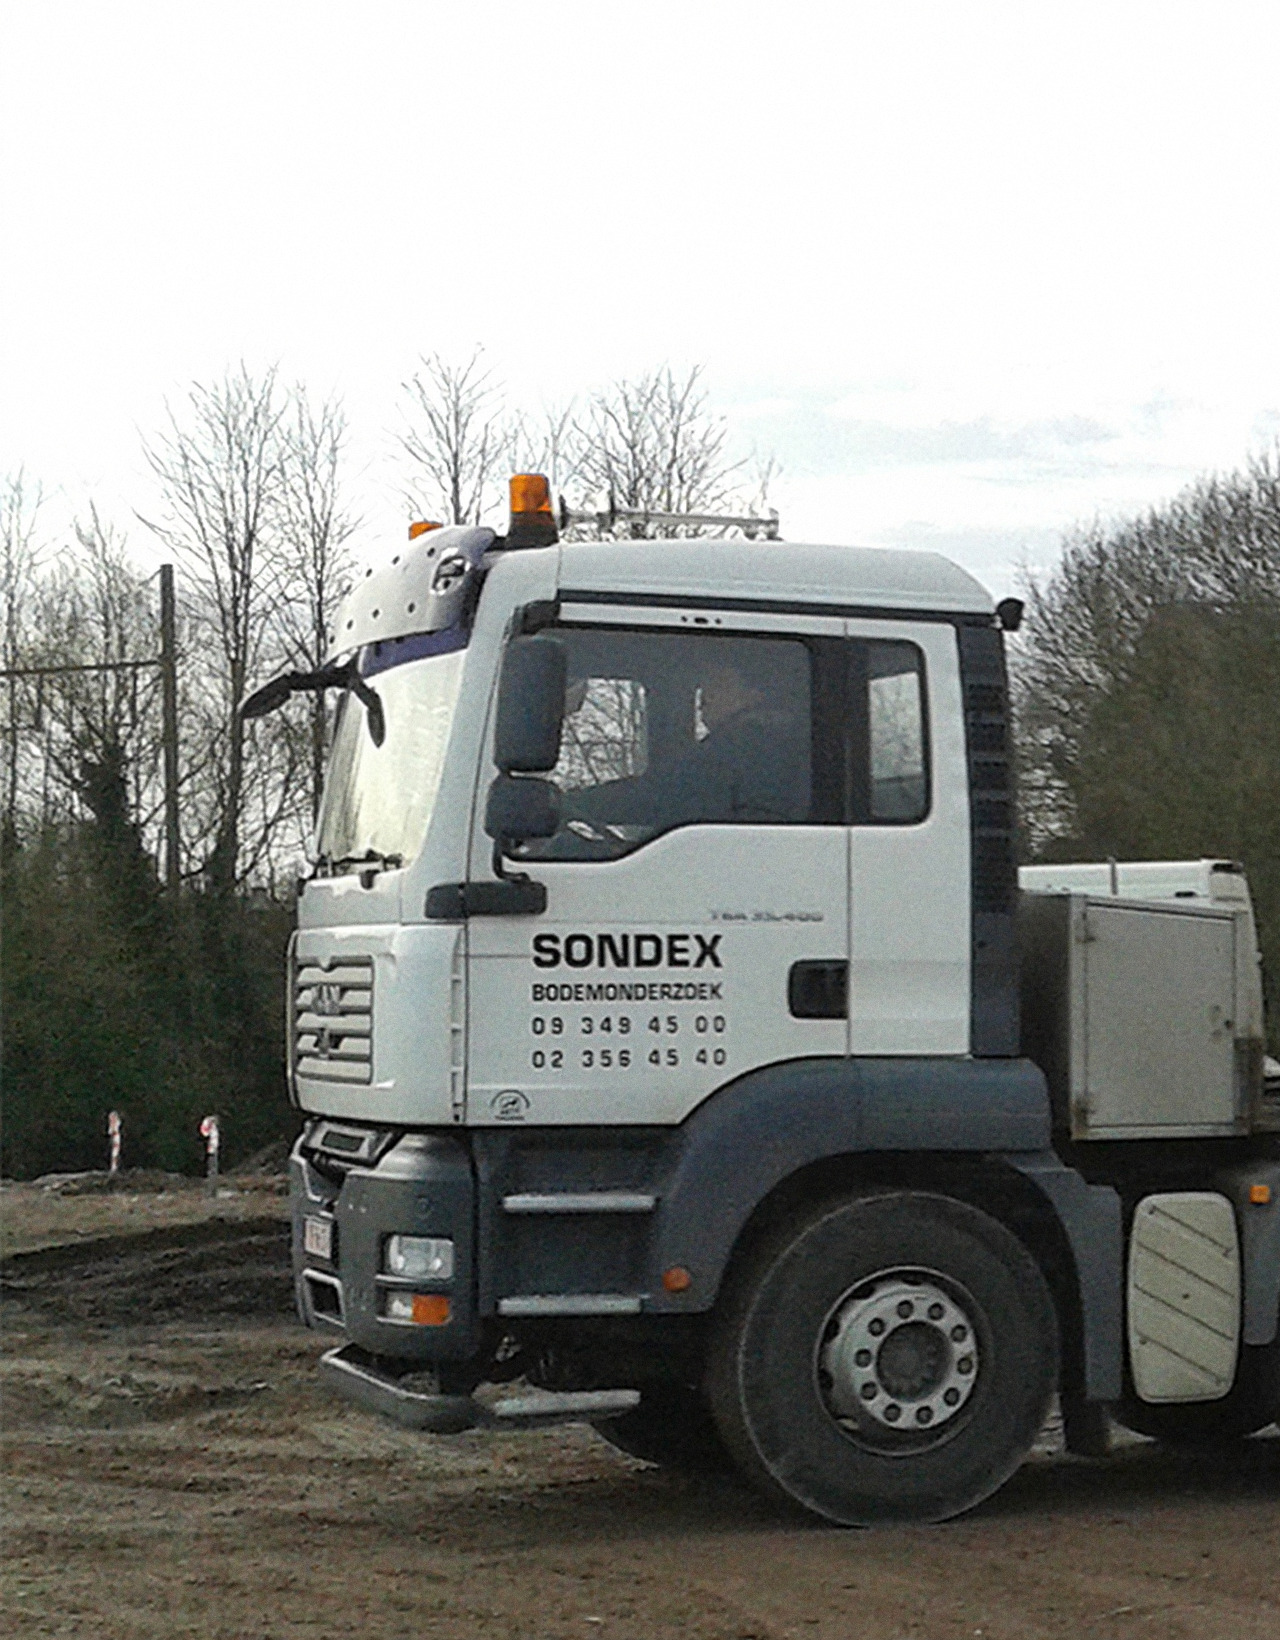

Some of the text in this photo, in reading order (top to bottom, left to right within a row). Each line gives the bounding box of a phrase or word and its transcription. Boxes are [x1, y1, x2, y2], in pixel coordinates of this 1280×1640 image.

[532, 933, 723, 968] SONDEX
[532, 983, 723, 1001] BODEMONDERZOEK
[532, 1016, 726, 1035] 09 349 45 00
[532, 1049, 727, 1068] 02 356 45 40
